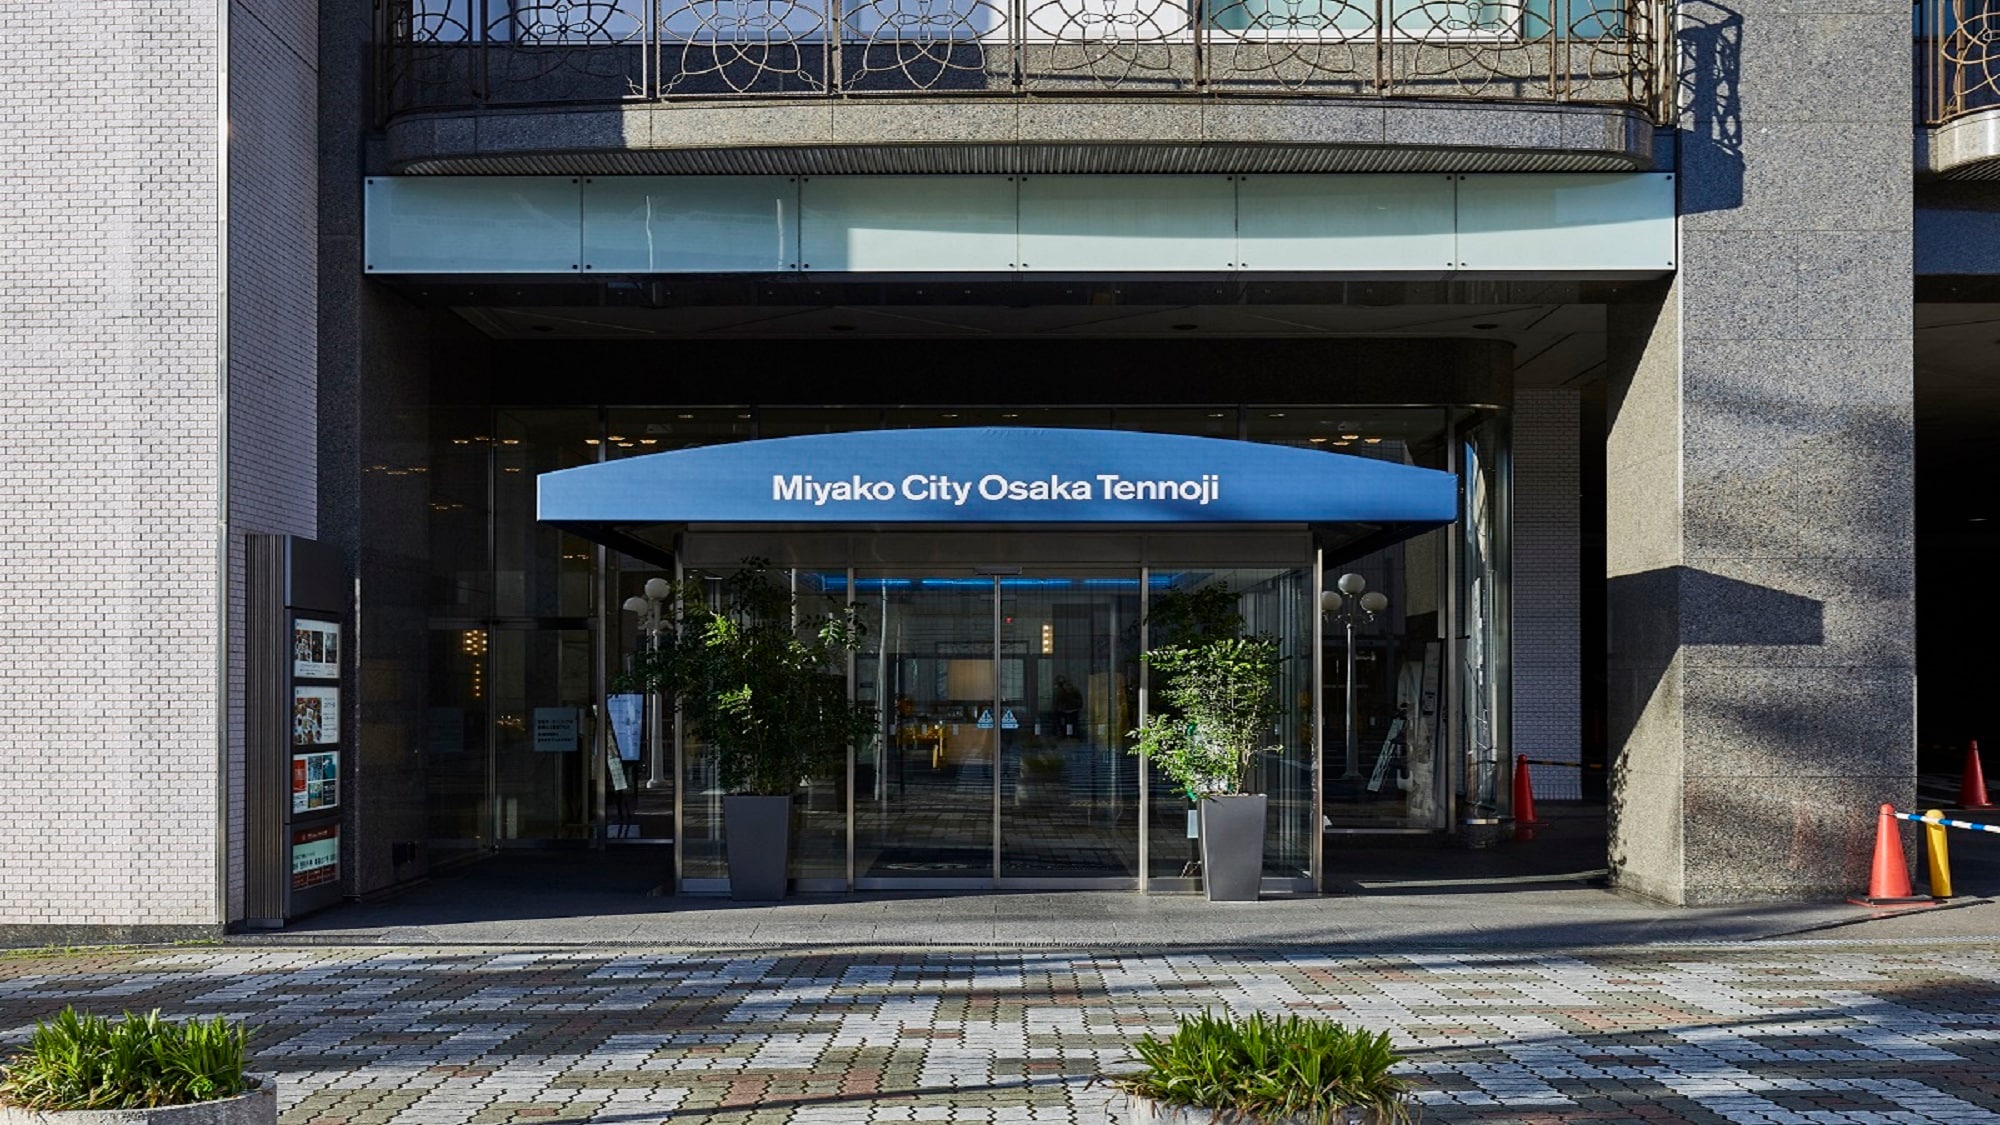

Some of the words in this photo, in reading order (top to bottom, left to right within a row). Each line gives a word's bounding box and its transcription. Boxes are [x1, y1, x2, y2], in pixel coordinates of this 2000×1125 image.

[773, 474, 896, 506] Miyako
[901, 474, 972, 506] City
[978, 474, 1092, 500] Osaka
[1096, 474, 1219, 505] Tennoji
